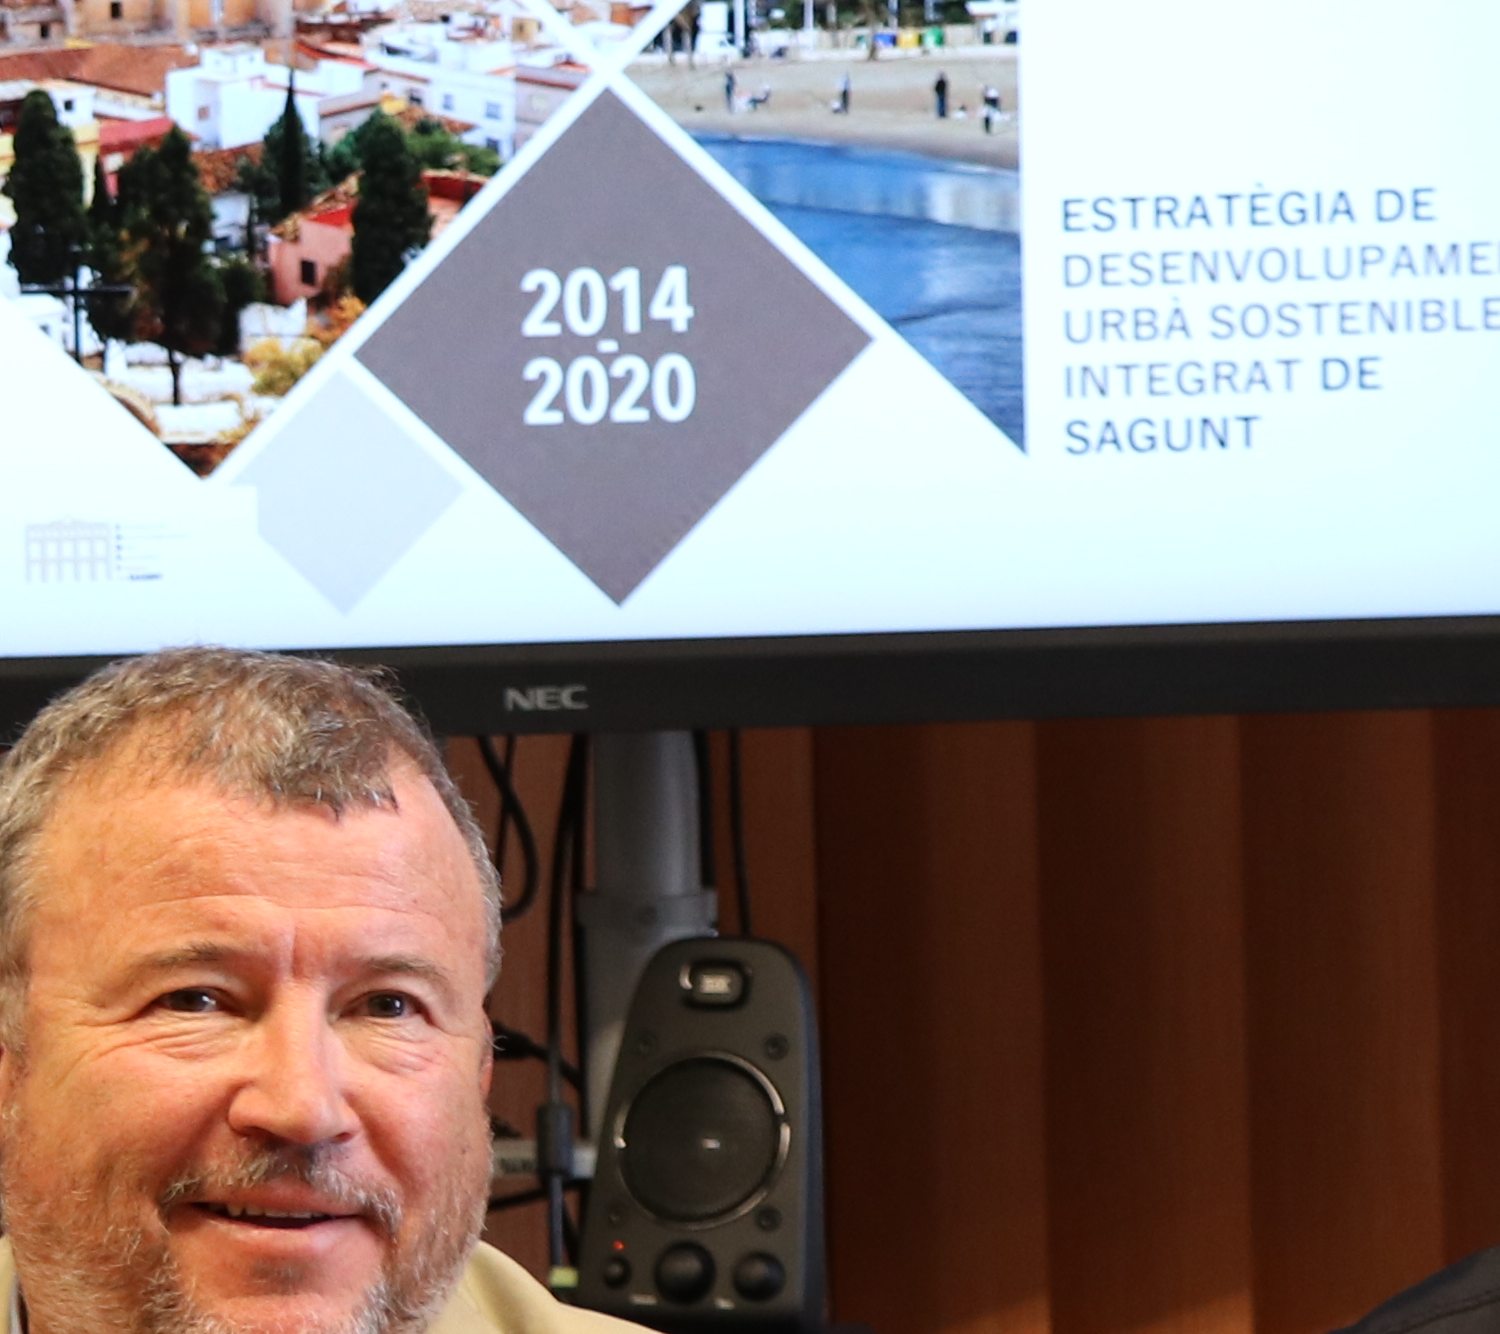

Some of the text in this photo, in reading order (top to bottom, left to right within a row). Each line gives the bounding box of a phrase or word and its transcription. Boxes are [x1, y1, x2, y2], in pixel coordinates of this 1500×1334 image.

[1375, 187, 1438, 223] DE
[520, 265, 695, 337] 2014
[522, 352, 696, 425] 2020
[1064, 356, 1384, 398] INTEGRAT DE
[1065, 415, 1261, 455] SAGUNT
[504, 684, 589, 711] NEC
